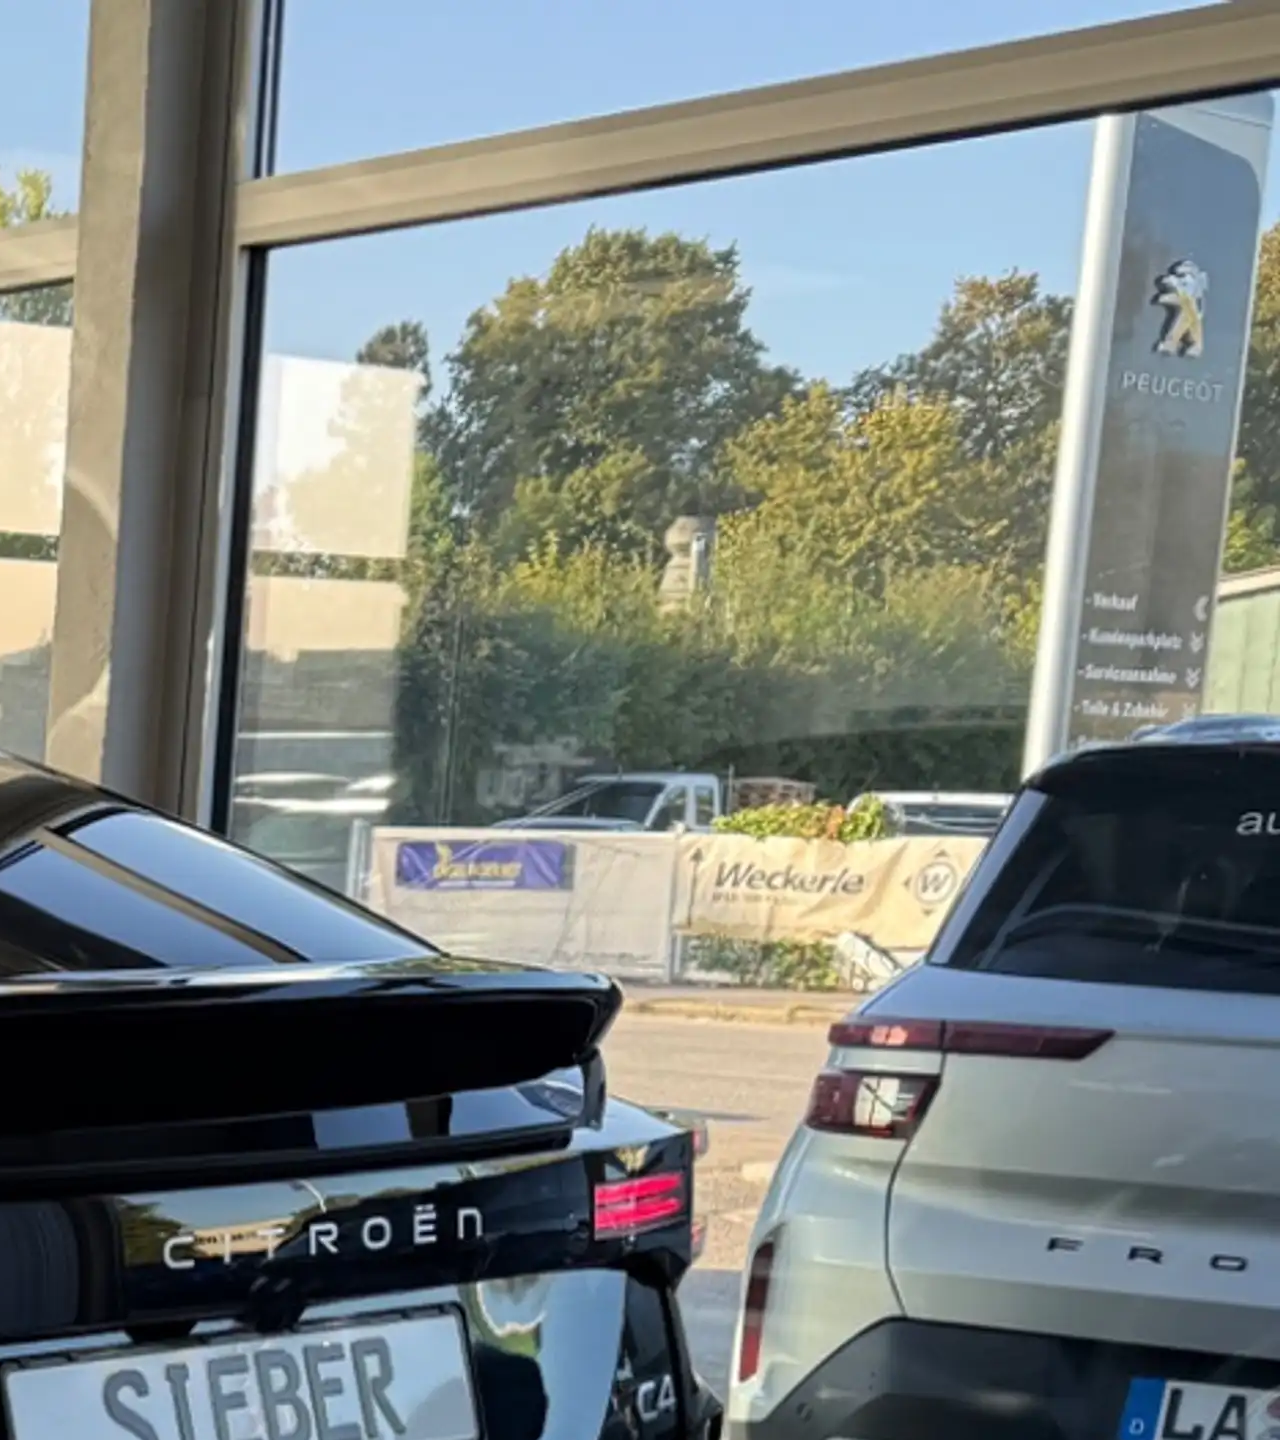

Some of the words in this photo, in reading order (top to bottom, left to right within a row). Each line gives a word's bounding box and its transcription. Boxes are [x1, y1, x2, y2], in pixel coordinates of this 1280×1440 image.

[1122, 370, 1224, 402] PEUGEOT
[715, 860, 865, 895] Weckerle
[637, 1374, 677, 1422] C4
